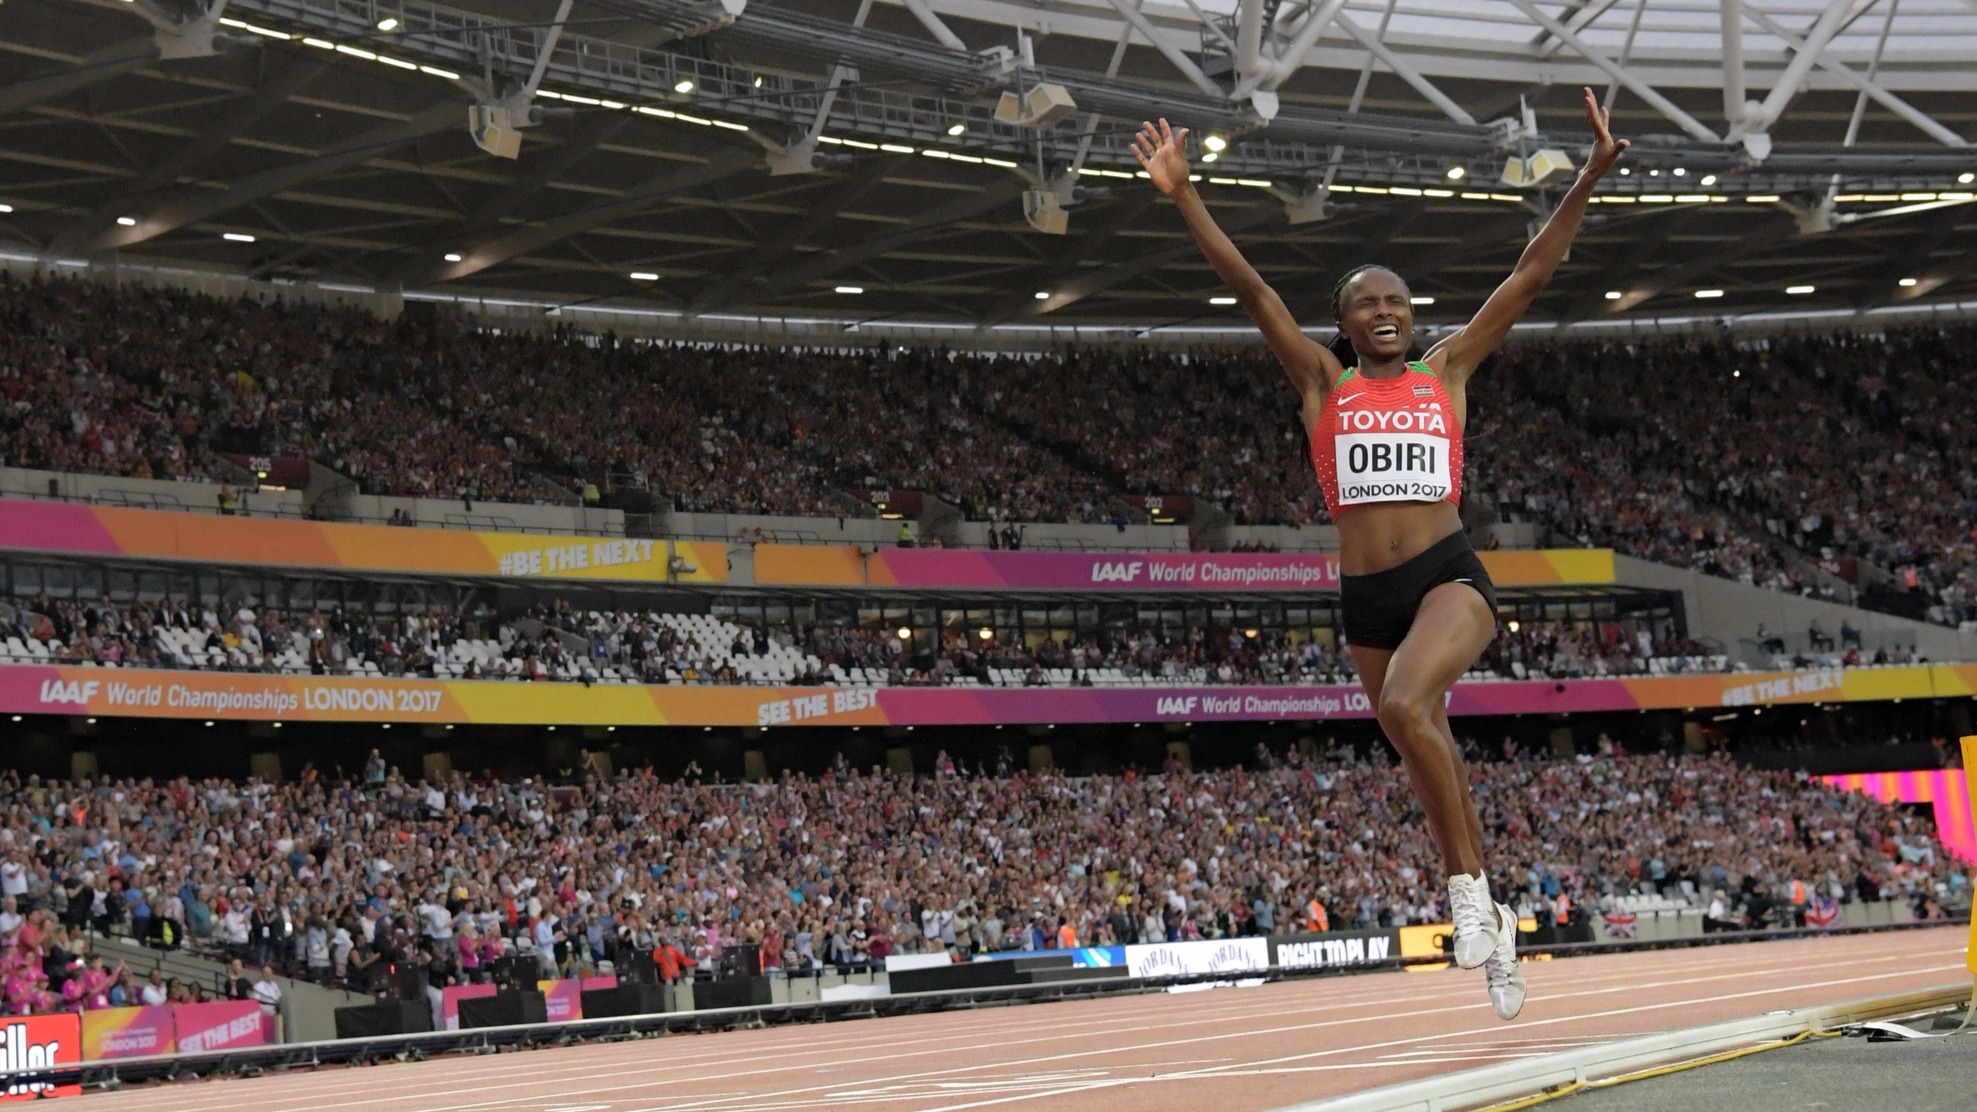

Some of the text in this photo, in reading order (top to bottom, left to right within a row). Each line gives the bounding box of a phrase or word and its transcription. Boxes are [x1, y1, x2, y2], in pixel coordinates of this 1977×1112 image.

[1339, 410, 1446, 434] TOYOTA
[1349, 443, 1435, 473] OBIRI
[1342, 482, 1447, 499] LONDON 2017
[501, 538, 654, 576] #BE THE NEXT
[1092, 561, 1142, 582] IAAF
[1149, 562, 1196, 581] World
[1201, 562, 1321, 585] Championships
[40, 680, 442, 714] IAAF World Championships LONDON 2017
[1756, 679, 1789, 700] THE
[758, 689, 878, 726] SEE THE BEST
[1157, 696, 1197, 714] IAAF
[1202, 697, 1240, 713] World
[1245, 695, 1340, 716] Championships
[1277, 942, 1324, 970] RIGHT
[1324, 939, 1347, 967] TO
[203, 1023, 229, 1048] THE
[230, 1010, 260, 1039] BEST
